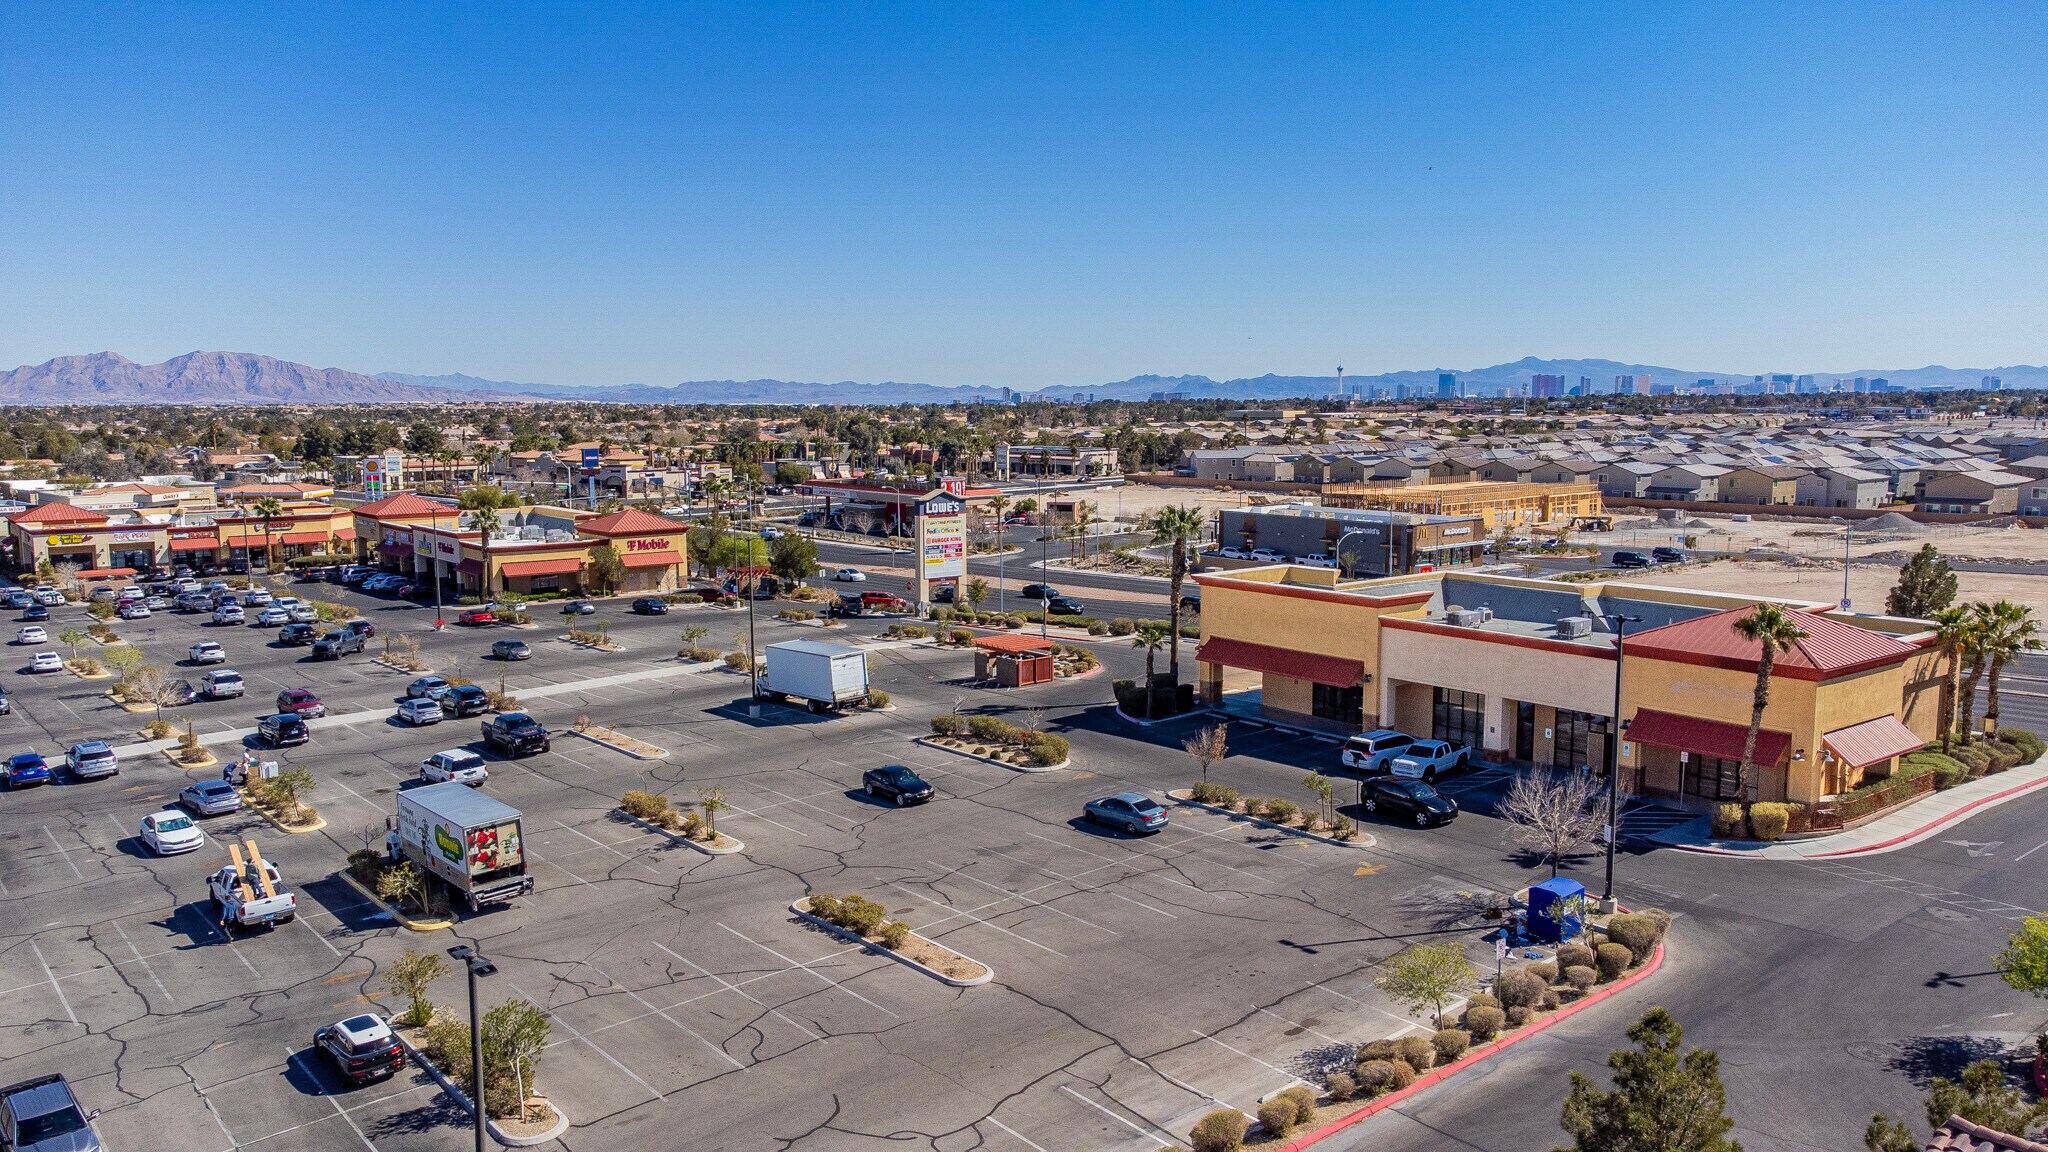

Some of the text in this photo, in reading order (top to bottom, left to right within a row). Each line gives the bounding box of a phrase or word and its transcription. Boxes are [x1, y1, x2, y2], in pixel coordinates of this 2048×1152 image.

[926, 501, 960, 514] LOWE'S
[1343, 526, 1380, 535] McDonald's
[1442, 527, 1471, 537] McDonald's
[637, 538, 670, 551] Mobile
